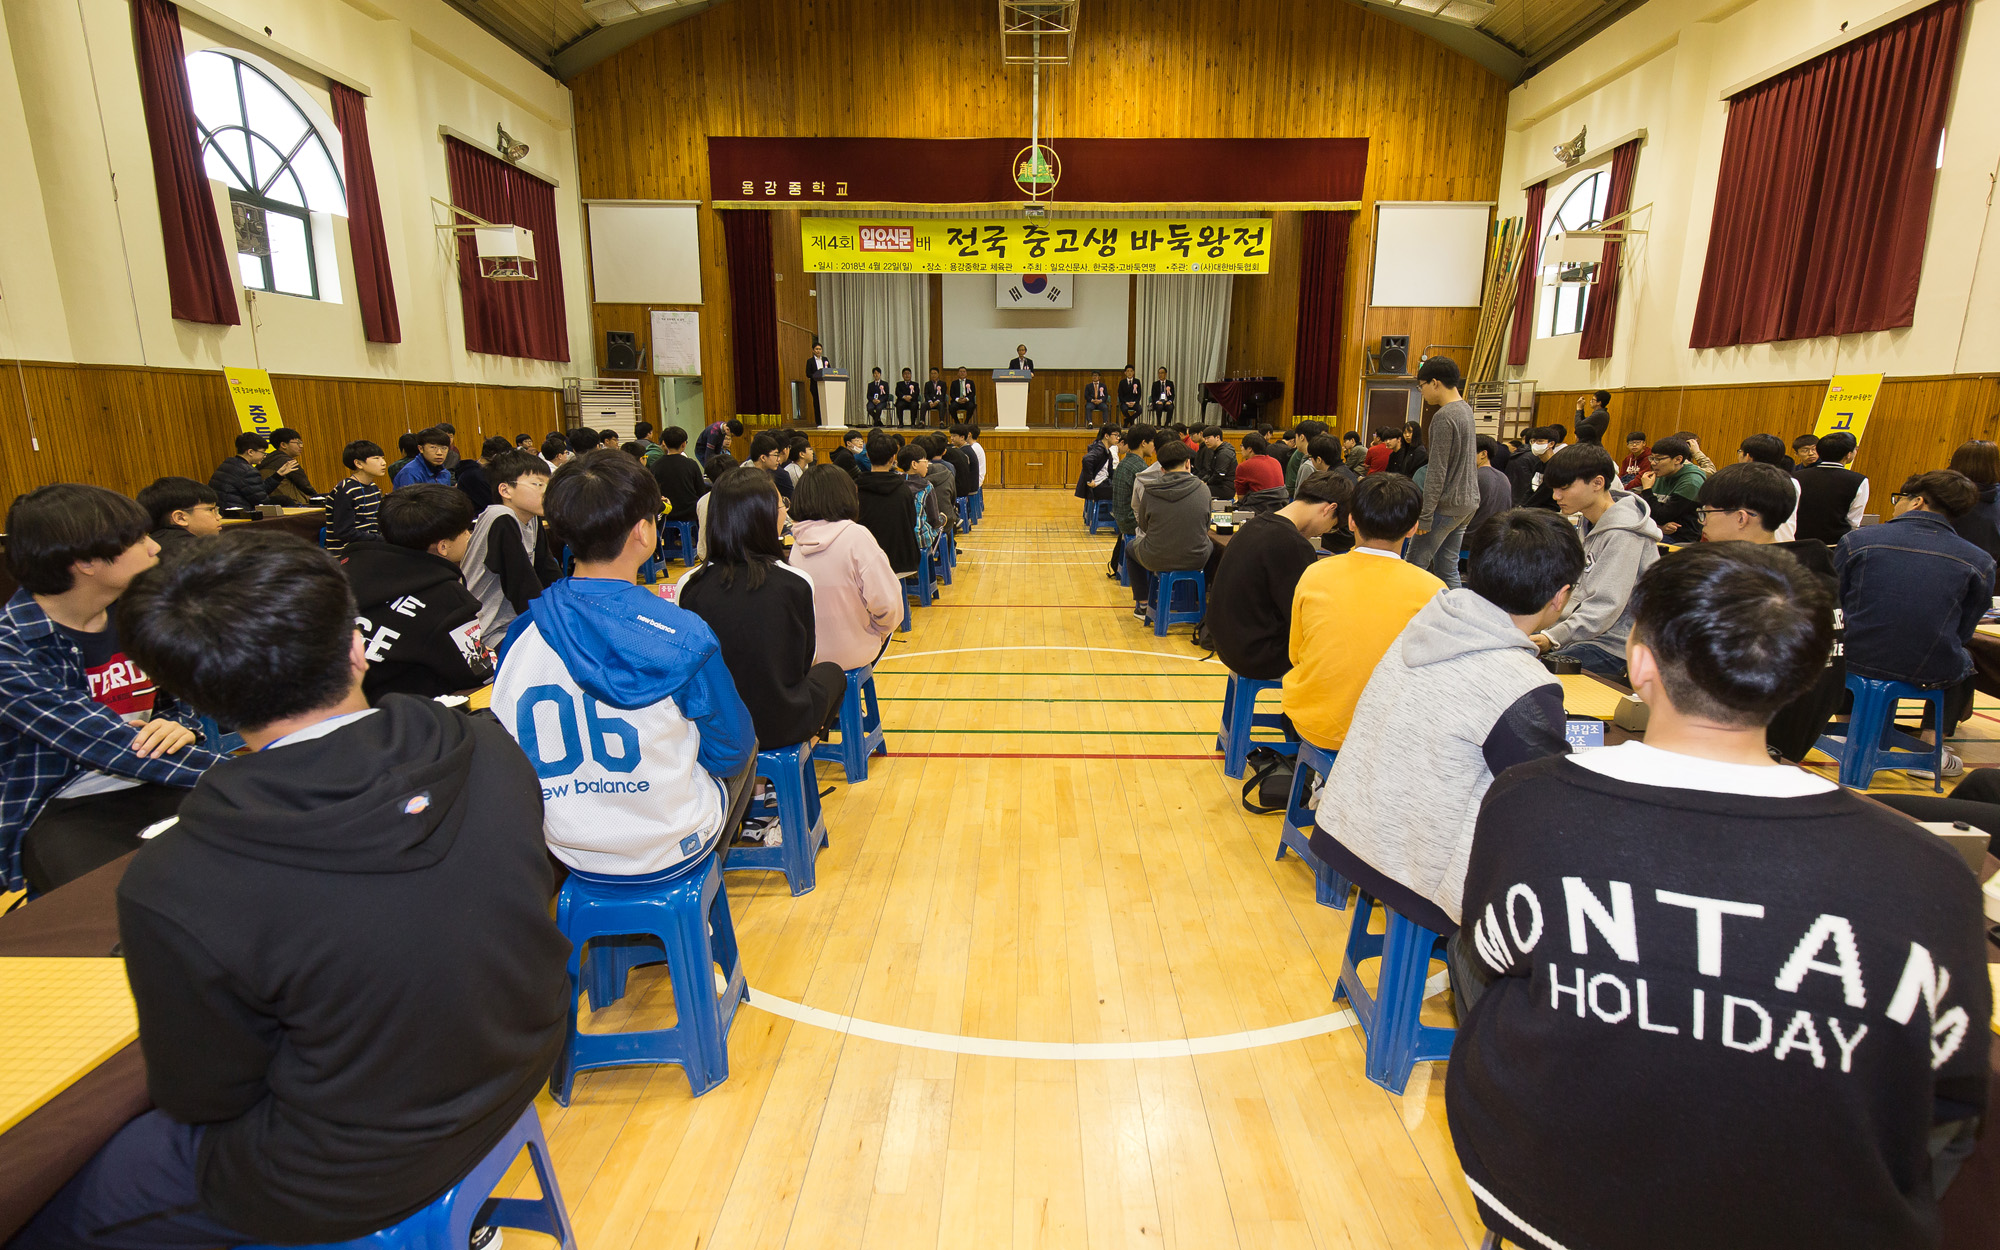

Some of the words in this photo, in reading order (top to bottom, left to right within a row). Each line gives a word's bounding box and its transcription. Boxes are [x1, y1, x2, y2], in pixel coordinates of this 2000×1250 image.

[741, 180, 848, 196] 용강중학교
[811, 235, 854, 251] 제4회
[860, 228, 911, 250] 일요신문
[916, 236, 931, 251] 배
[947, 225, 1008, 258] 전국
[1022, 224, 1118, 258] 중고생
[1130, 224, 1265, 258] 바둑왕전
[818, 262, 833, 271] 일시
[841, 262, 866, 271] 2018년
[868, 262, 881, 271] 4월
[883, 262, 913, 271] 22일(일)
[926, 263, 942, 271] 장소
[950, 263, 987, 272] 용강중학교
[990, 263, 1013, 272] 체육관
[1830, 412, 1854, 430] 고
[516, 684, 642, 779] 06
[542, 783, 569, 801] ew
[574, 778, 651, 795] balance
[1548, 962, 1869, 1073] HOLIDAY
